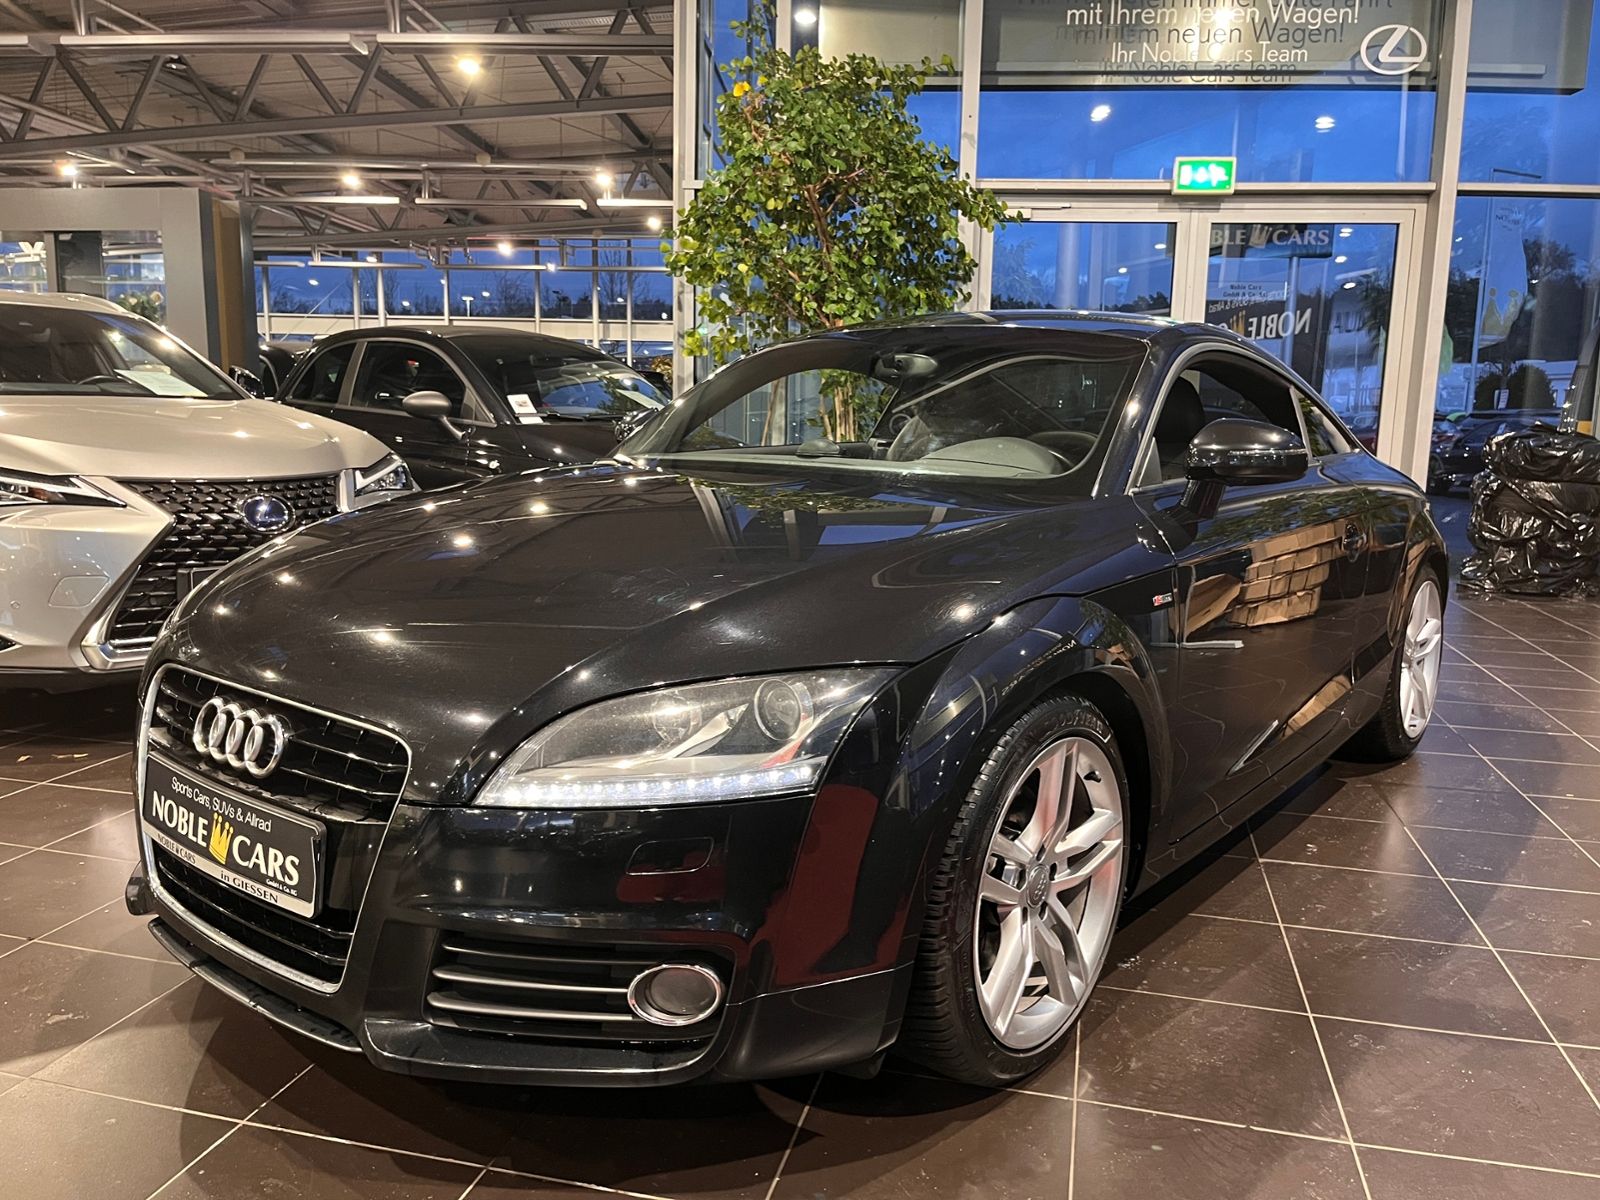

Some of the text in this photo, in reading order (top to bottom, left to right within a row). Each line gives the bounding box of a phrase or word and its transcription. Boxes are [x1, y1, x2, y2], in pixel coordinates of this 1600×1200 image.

[1066, 3, 1103, 25] mit
[1109, 0, 1177, 25] Ihrem
[1267, 0, 1359, 29] Wagen!
[1111, 42, 1137, 63] Ihr
[1259, 41, 1308, 63] Team
[1272, 230, 1329, 245] CARS
[171, 776, 272, 832] Sports Cars, SUVs & Allrad
[152, 790, 300, 886] NOBLE CARS
[157, 833, 197, 865] NOBLE CARS
[221, 870, 279, 904] in GIESSEN
